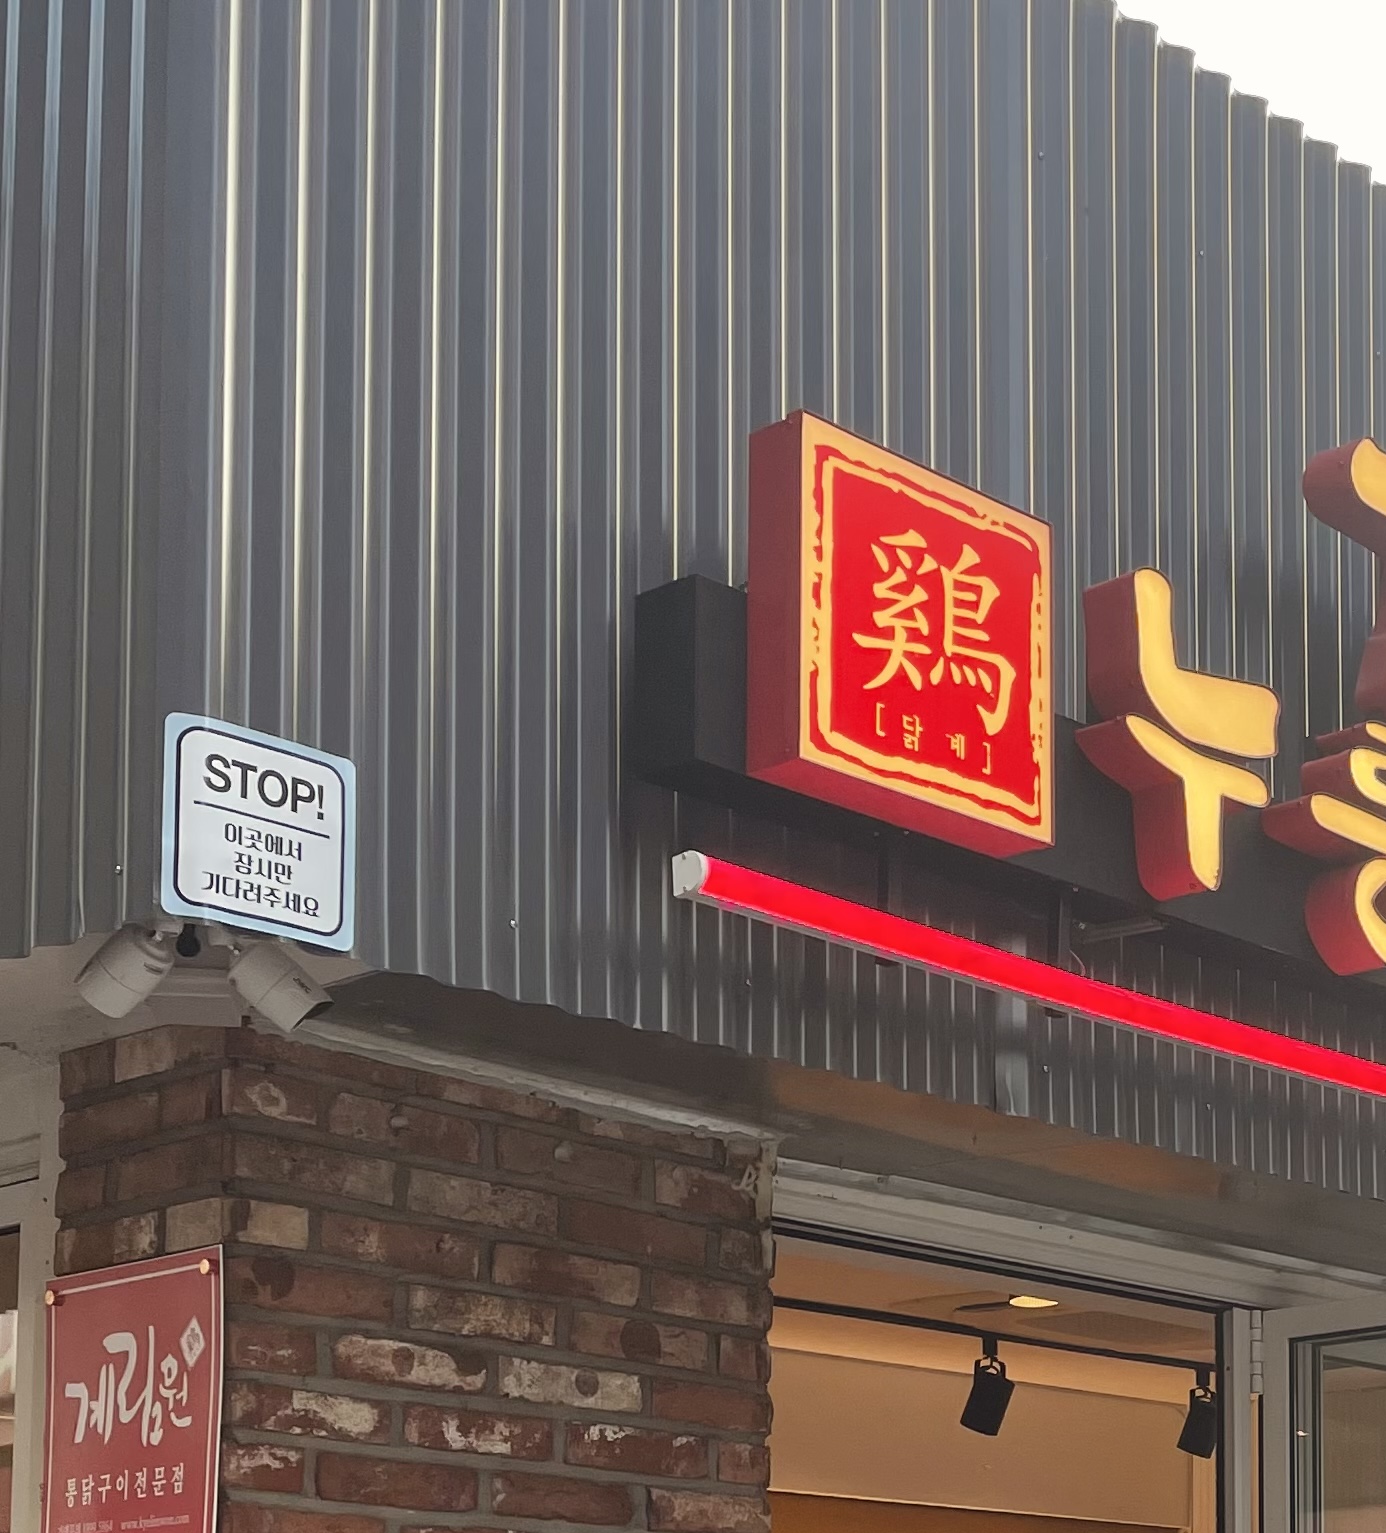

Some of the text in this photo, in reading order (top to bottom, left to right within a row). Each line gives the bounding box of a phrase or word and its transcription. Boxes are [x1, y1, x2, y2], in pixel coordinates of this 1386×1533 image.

[203, 753, 325, 820] STOP!
[223, 822, 303, 862] 이곳에서
[233, 851, 293, 885] 잠시만
[200, 871, 320, 918] 기다려주세요
[64, 1324, 193, 1448] 계림원
[65, 1462, 185, 1508] 통닭구이전문점
